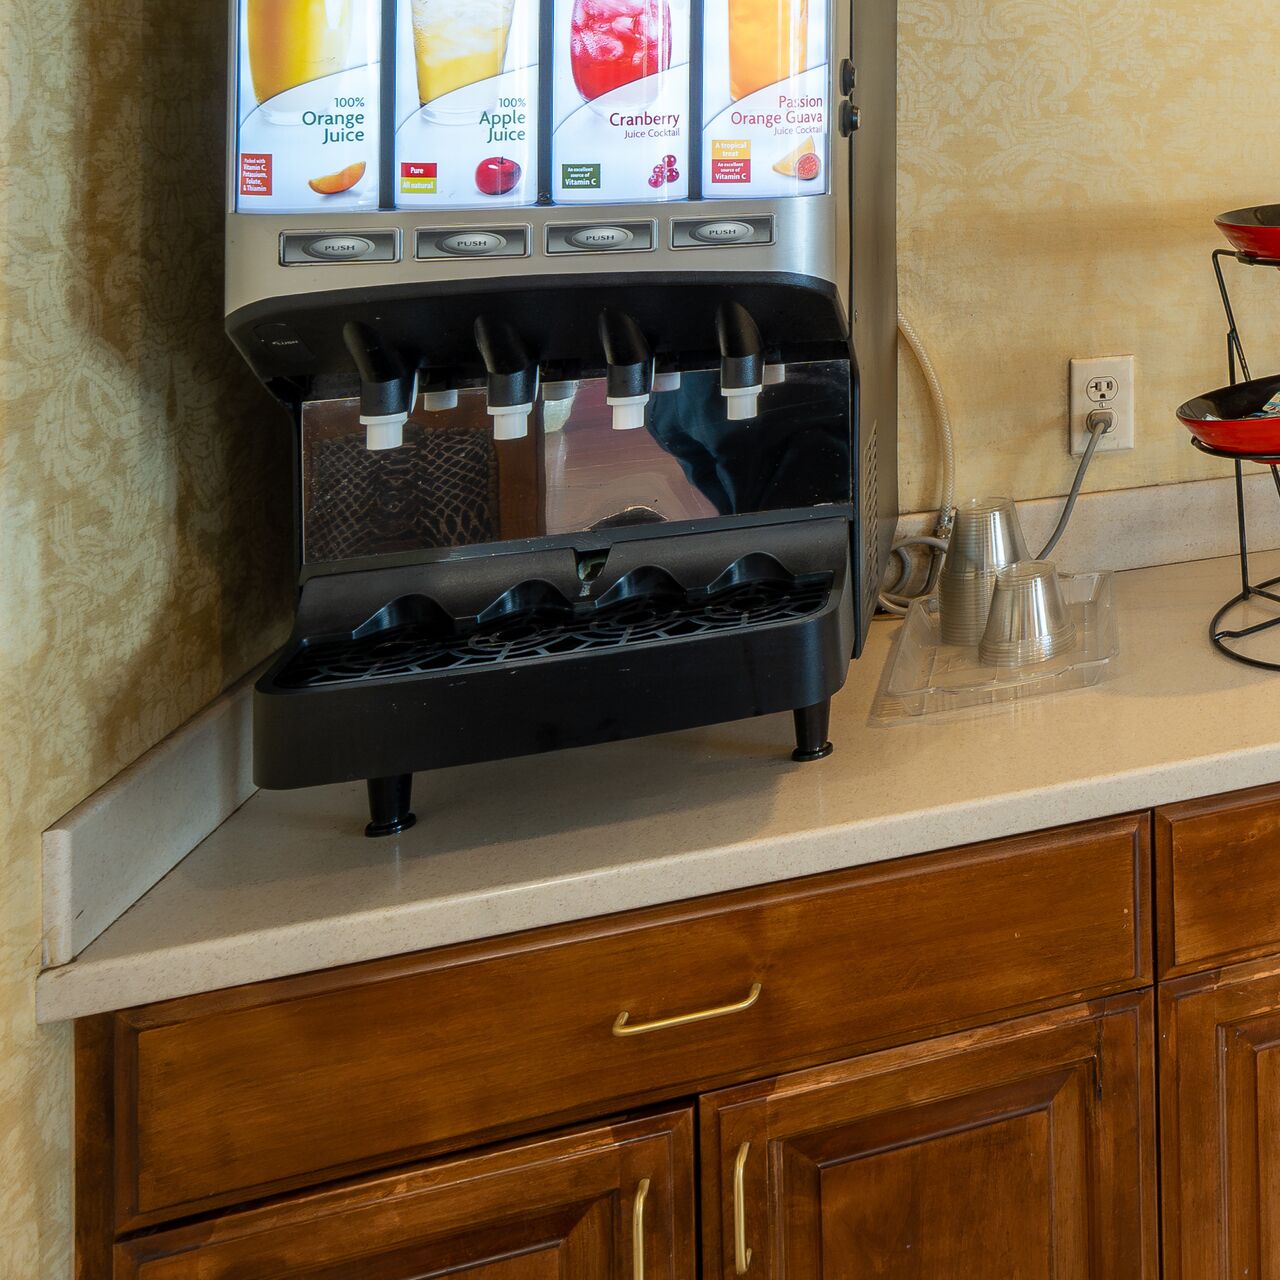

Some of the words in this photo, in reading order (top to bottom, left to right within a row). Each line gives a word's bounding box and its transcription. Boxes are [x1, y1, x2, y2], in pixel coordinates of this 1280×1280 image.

[334, 97, 365, 108] 100%
[499, 97, 526, 108] 100%
[302, 111, 365, 129] Orange
[479, 109, 526, 129] Apple
[609, 111, 680, 128] Cranberry
[731, 111, 782, 128] Orange
[786, 110, 823, 124] Guava
[486, 127, 526, 144] Juice
[624, 129, 646, 140] Juice
[647, 128, 680, 138] Cocktail
[774, 126, 793, 136] Juice
[795, 125, 823, 134] Cocktail
[322, 128, 365, 145] Juice
[721, 141, 747, 150] tropical
[410, 166, 424, 174] Pure
[411, 181, 433, 189] natural
[565, 178, 590, 186] Vitamin
